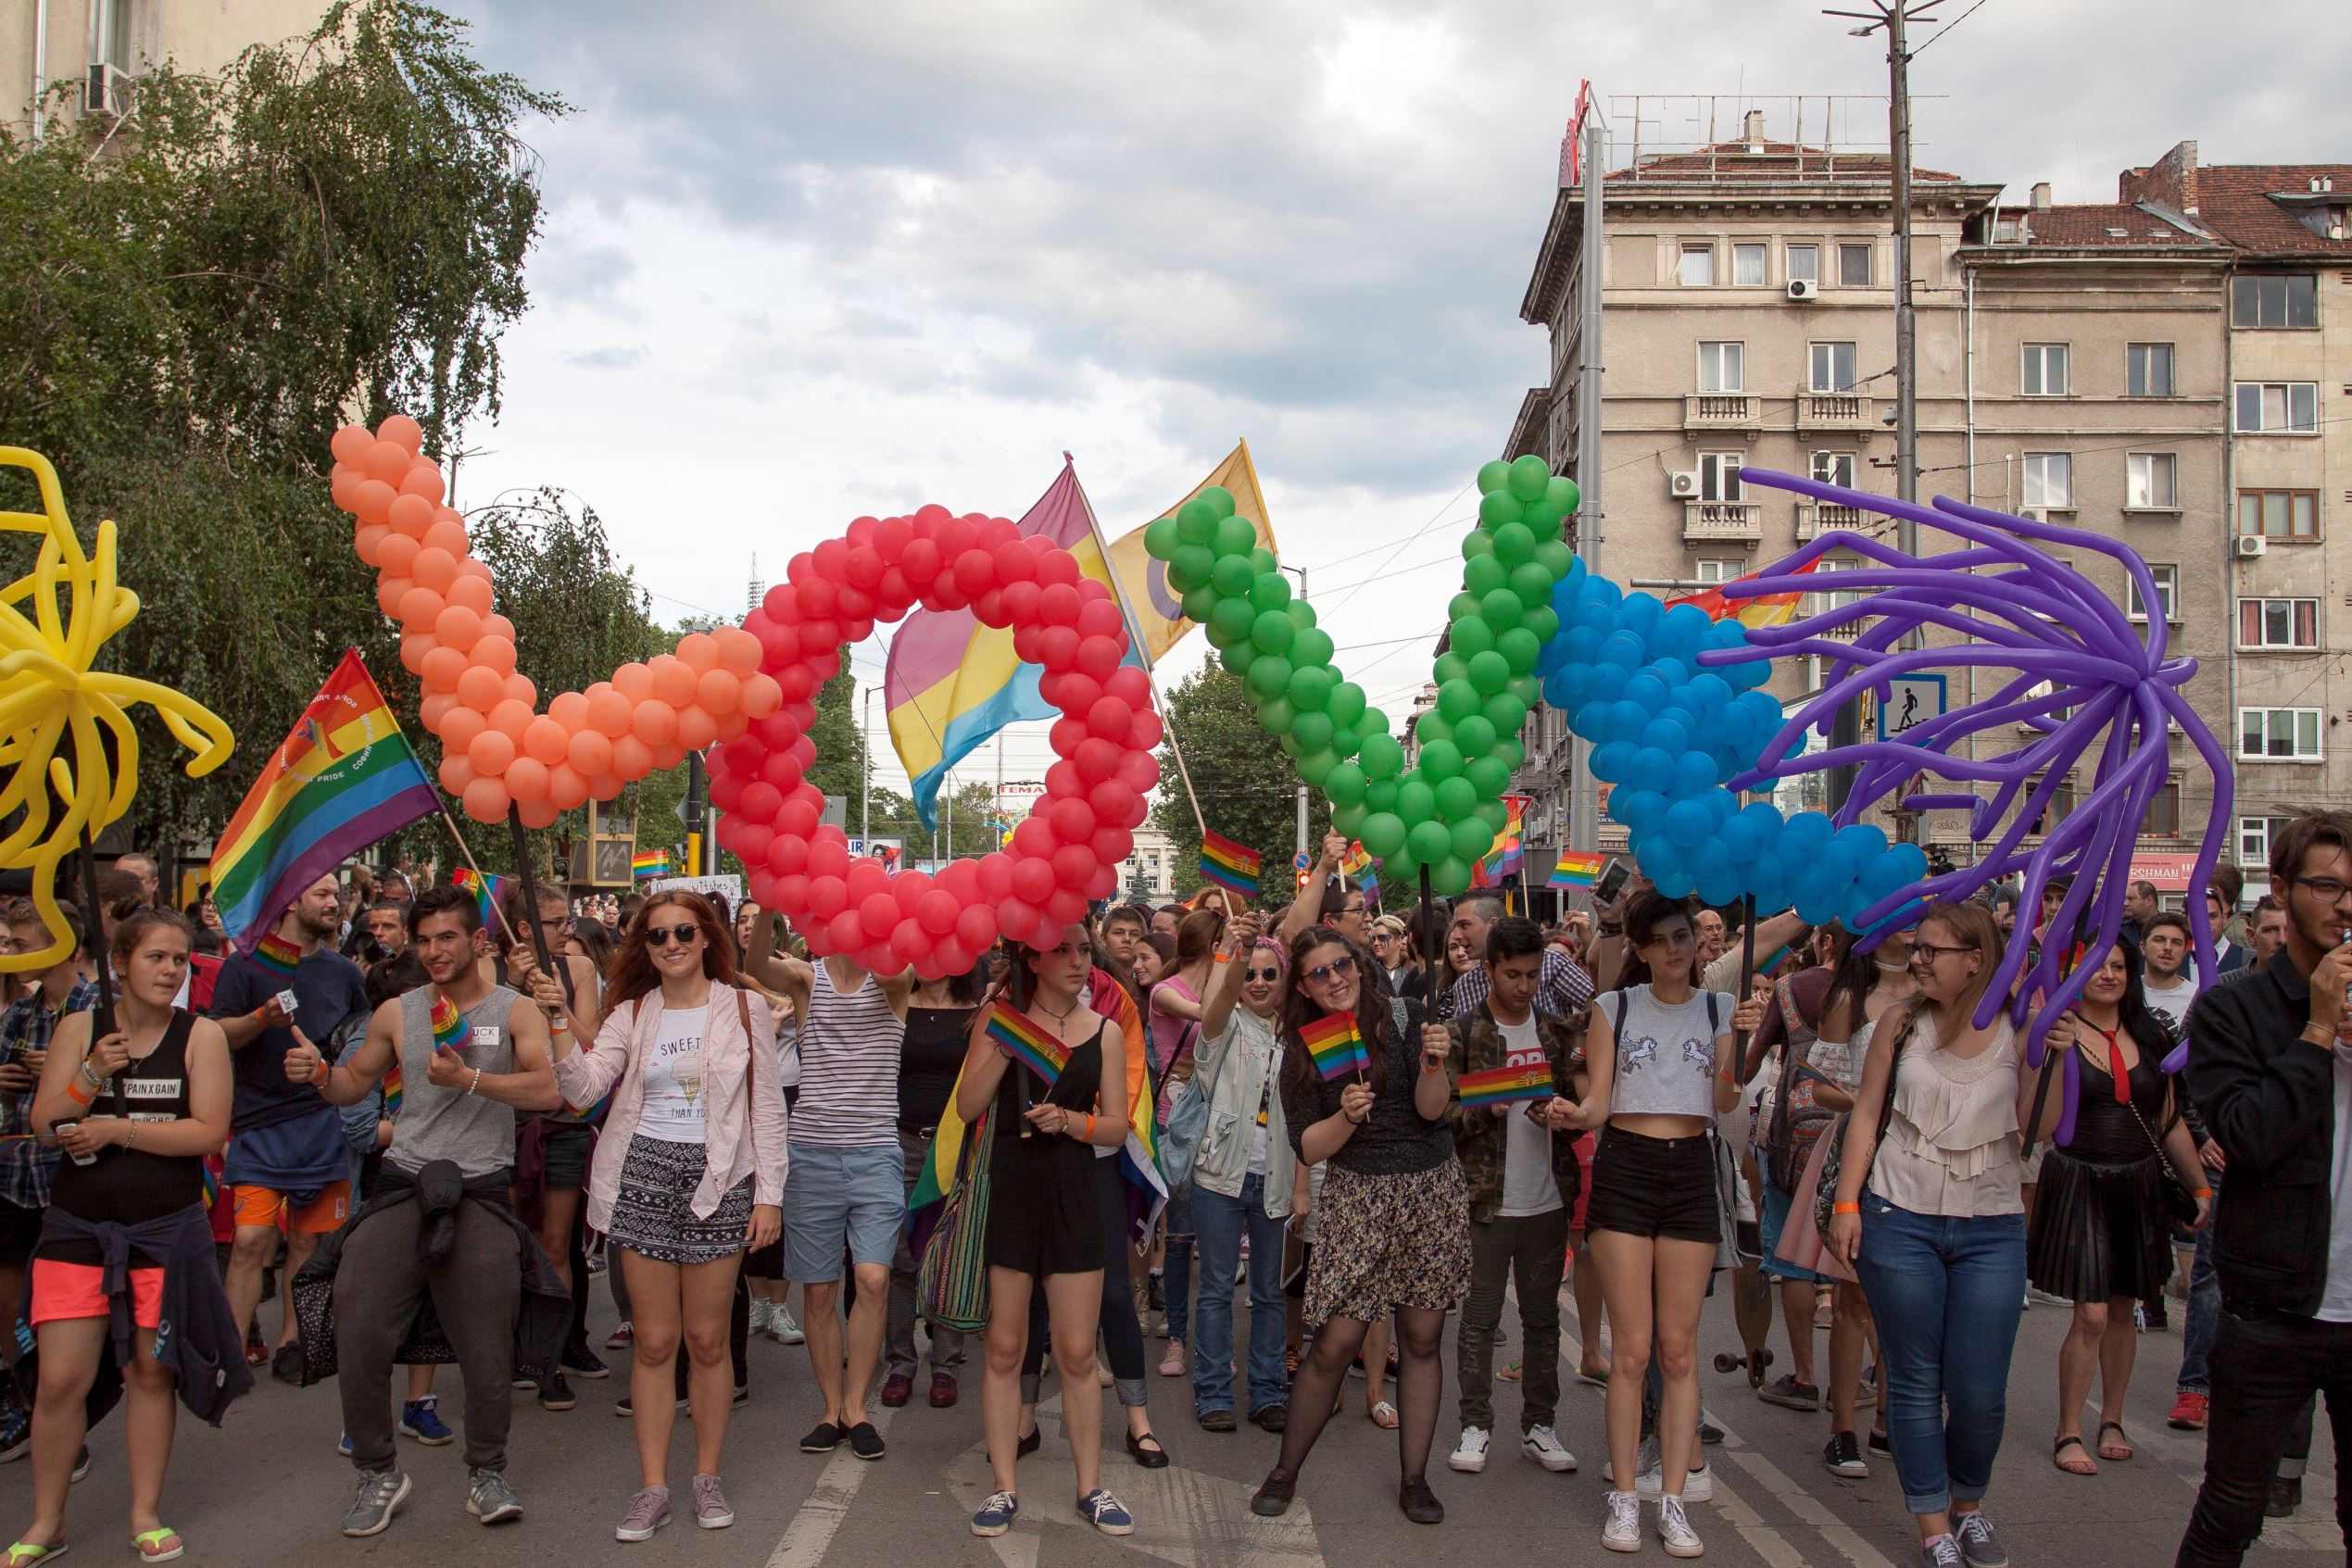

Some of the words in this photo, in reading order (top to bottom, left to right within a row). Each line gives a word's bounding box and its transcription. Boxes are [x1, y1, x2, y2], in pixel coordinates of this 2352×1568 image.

[317, 771, 346, 783] PRIDE
[127, 1084, 147, 1094] PAIN
[148, 1084, 154, 1094] X
[155, 1084, 176, 1094] GAIN
[671, 1108, 692, 1118] THAN
